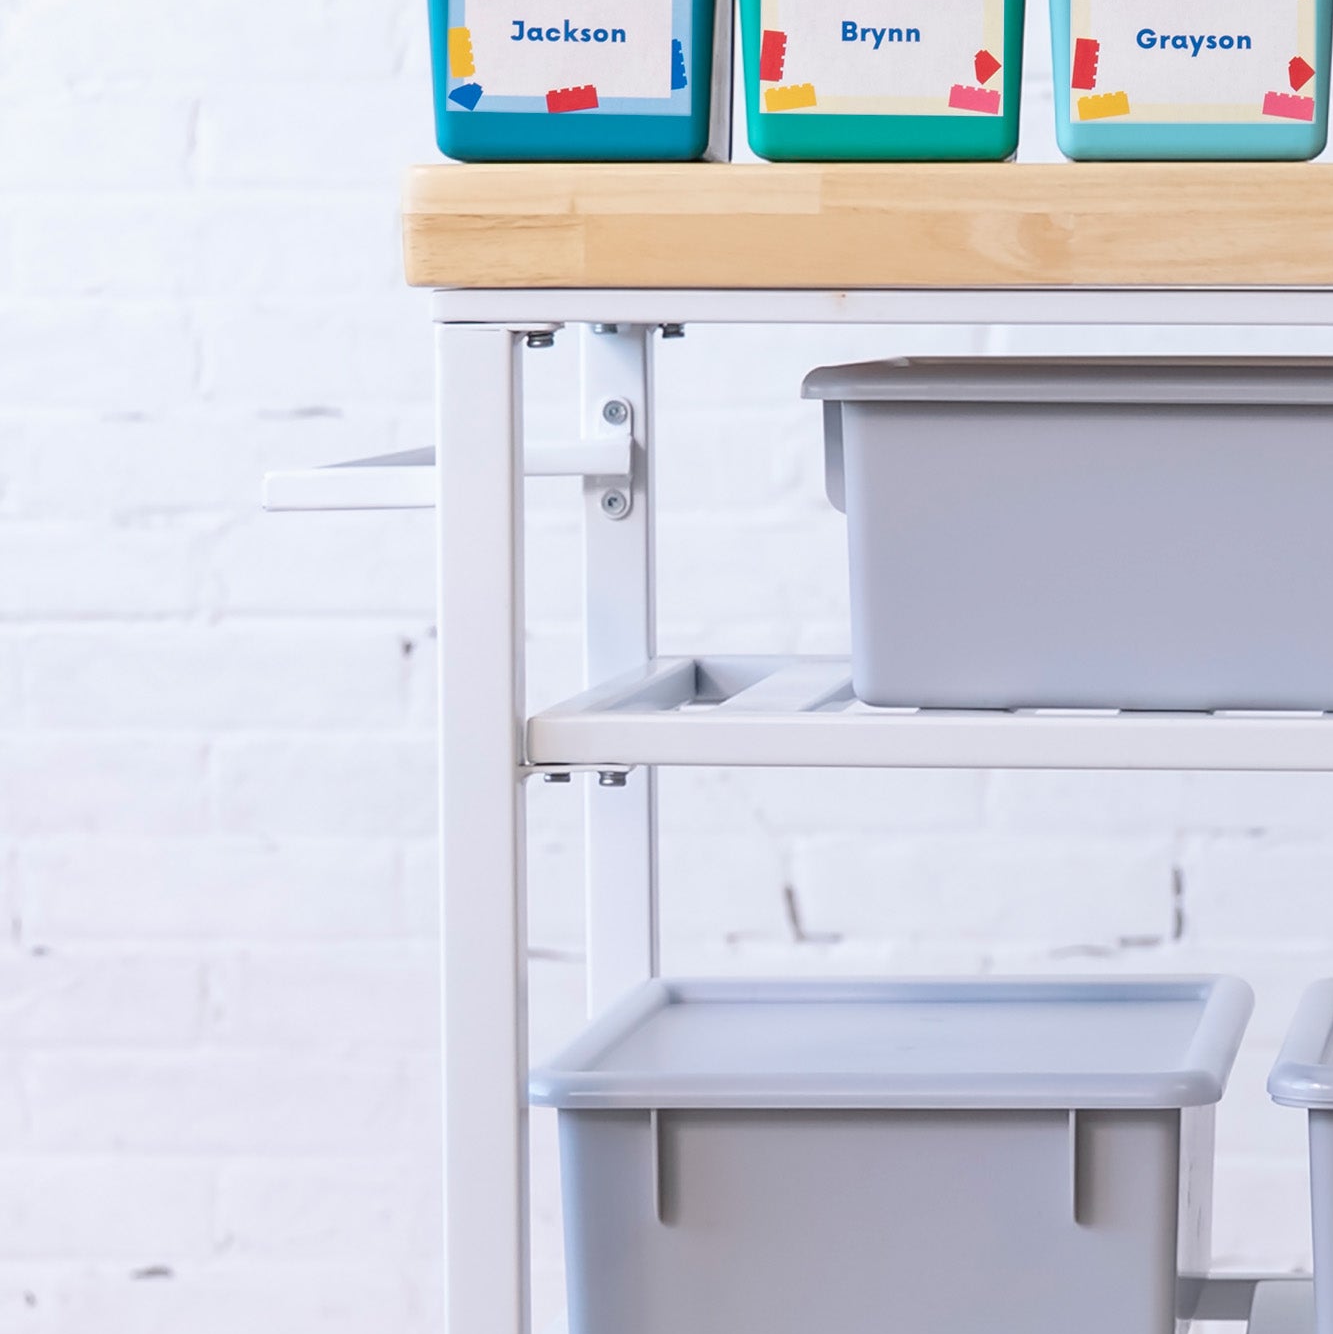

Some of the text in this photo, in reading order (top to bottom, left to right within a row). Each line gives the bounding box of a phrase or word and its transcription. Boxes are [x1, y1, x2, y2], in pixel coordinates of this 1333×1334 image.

[510, 18, 626, 43] Jackson
[841, 20, 921, 50] Brynn
[1136, 28, 1252, 58] Grayson
